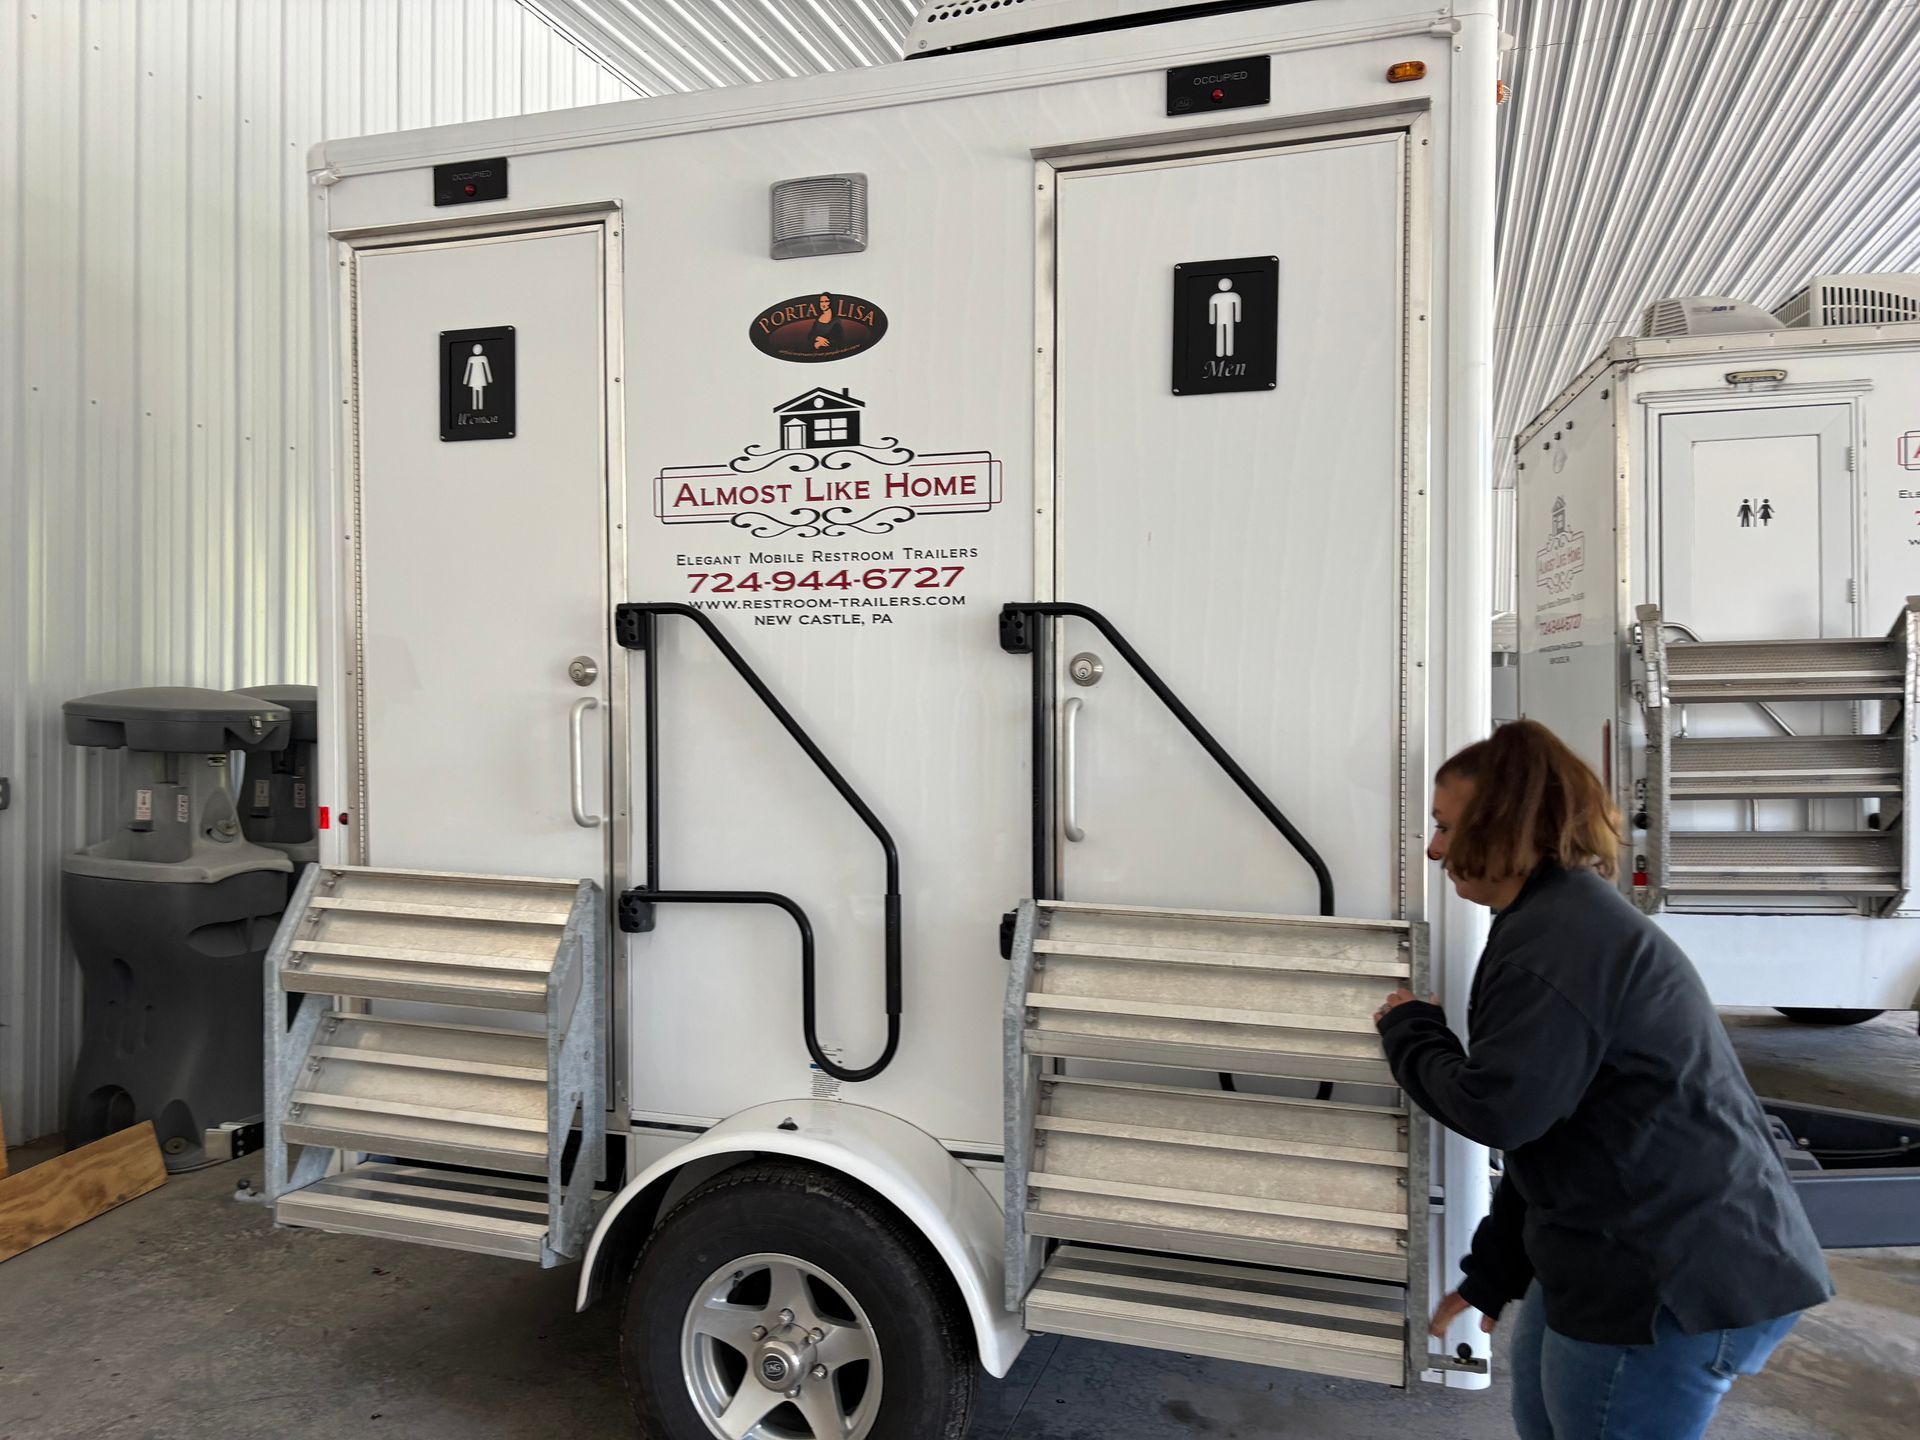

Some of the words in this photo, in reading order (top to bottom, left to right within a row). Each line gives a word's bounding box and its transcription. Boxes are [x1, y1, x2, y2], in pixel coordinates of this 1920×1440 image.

[1193, 71, 1248, 86] OCCUPIED
[758, 303, 818, 334] PORTA
[837, 299, 876, 327] LISA
[1201, 360, 1247, 379] Men
[672, 483, 792, 507] ALMOST
[805, 477, 870, 501] LIKE
[884, 472, 976, 498] HOME
[676, 554, 741, 565] ELEGANT
[749, 552, 804, 564] MOBILE
[812, 550, 894, 563] RESTROOM
[903, 547, 978, 560] TRAILERS
[687, 566, 966, 593] 724-944-6727
[688, 595, 966, 609] WWW.RESTROOM-TRAILERS.COM
[754, 615, 792, 625] NEW
[799, 613, 865, 626] CASTLE,
[872, 613, 893, 624] PA
